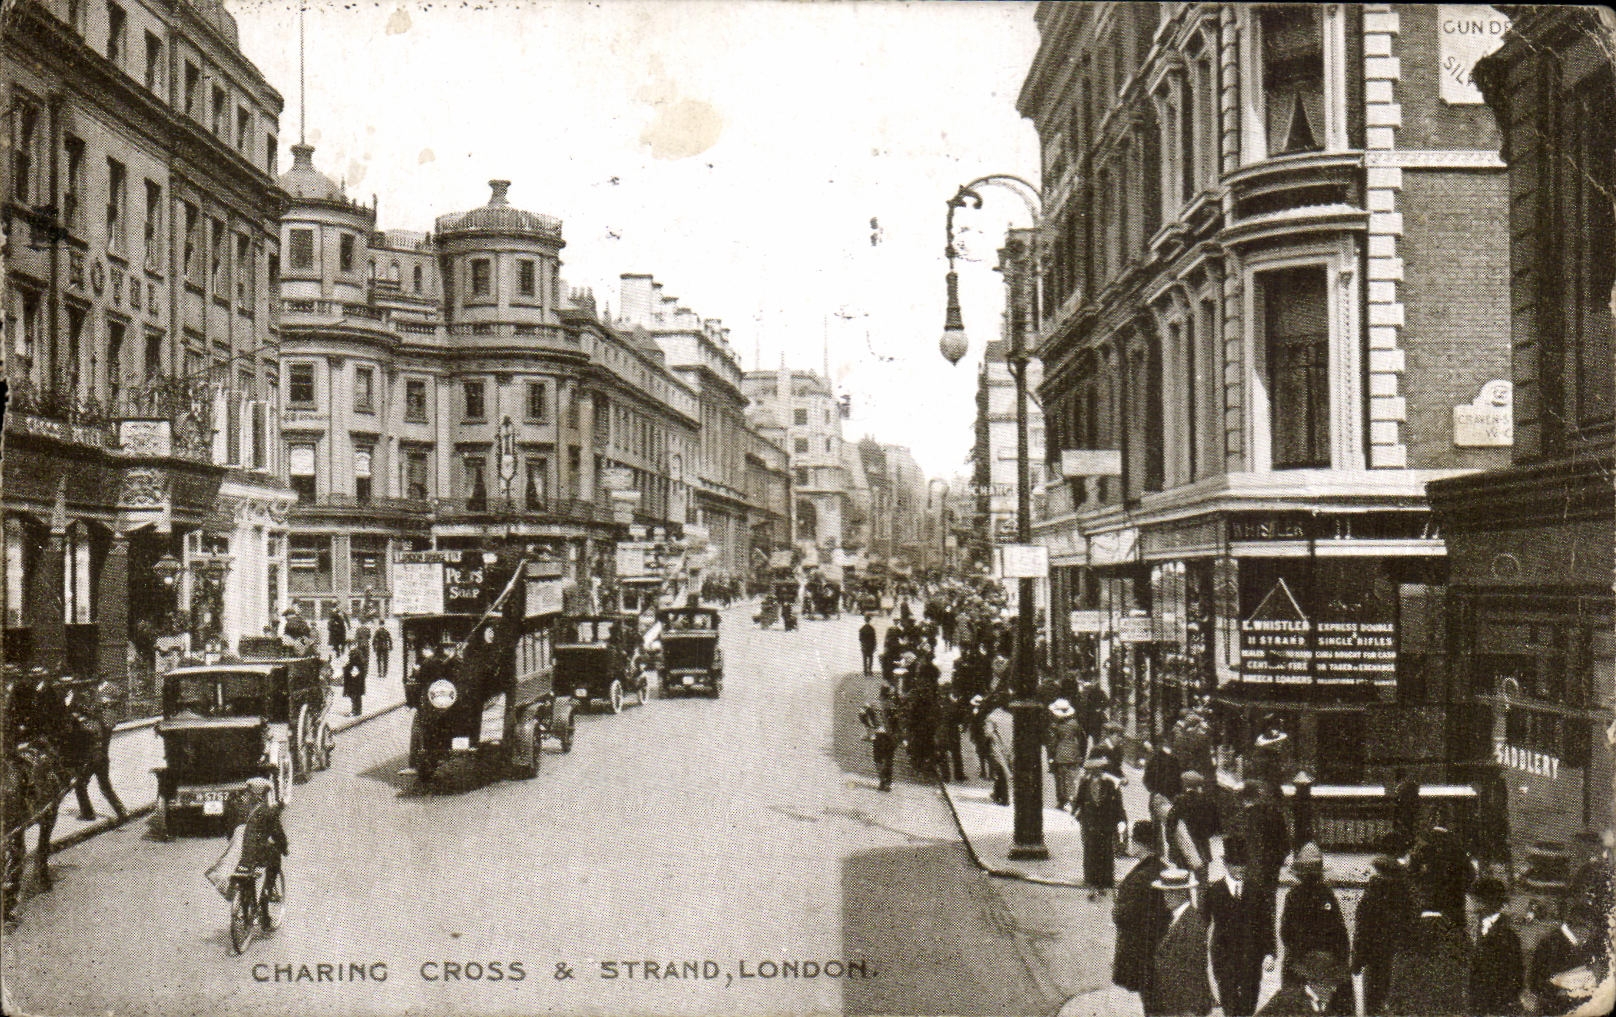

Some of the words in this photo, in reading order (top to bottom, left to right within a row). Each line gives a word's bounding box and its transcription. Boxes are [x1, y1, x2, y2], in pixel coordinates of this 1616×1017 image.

[1443, 20, 1483, 34] GUN
[1259, 635, 1306, 645] STRAND
[1318, 637, 1353, 646] SINGLE
[1356, 637, 1393, 646] RIFLES
